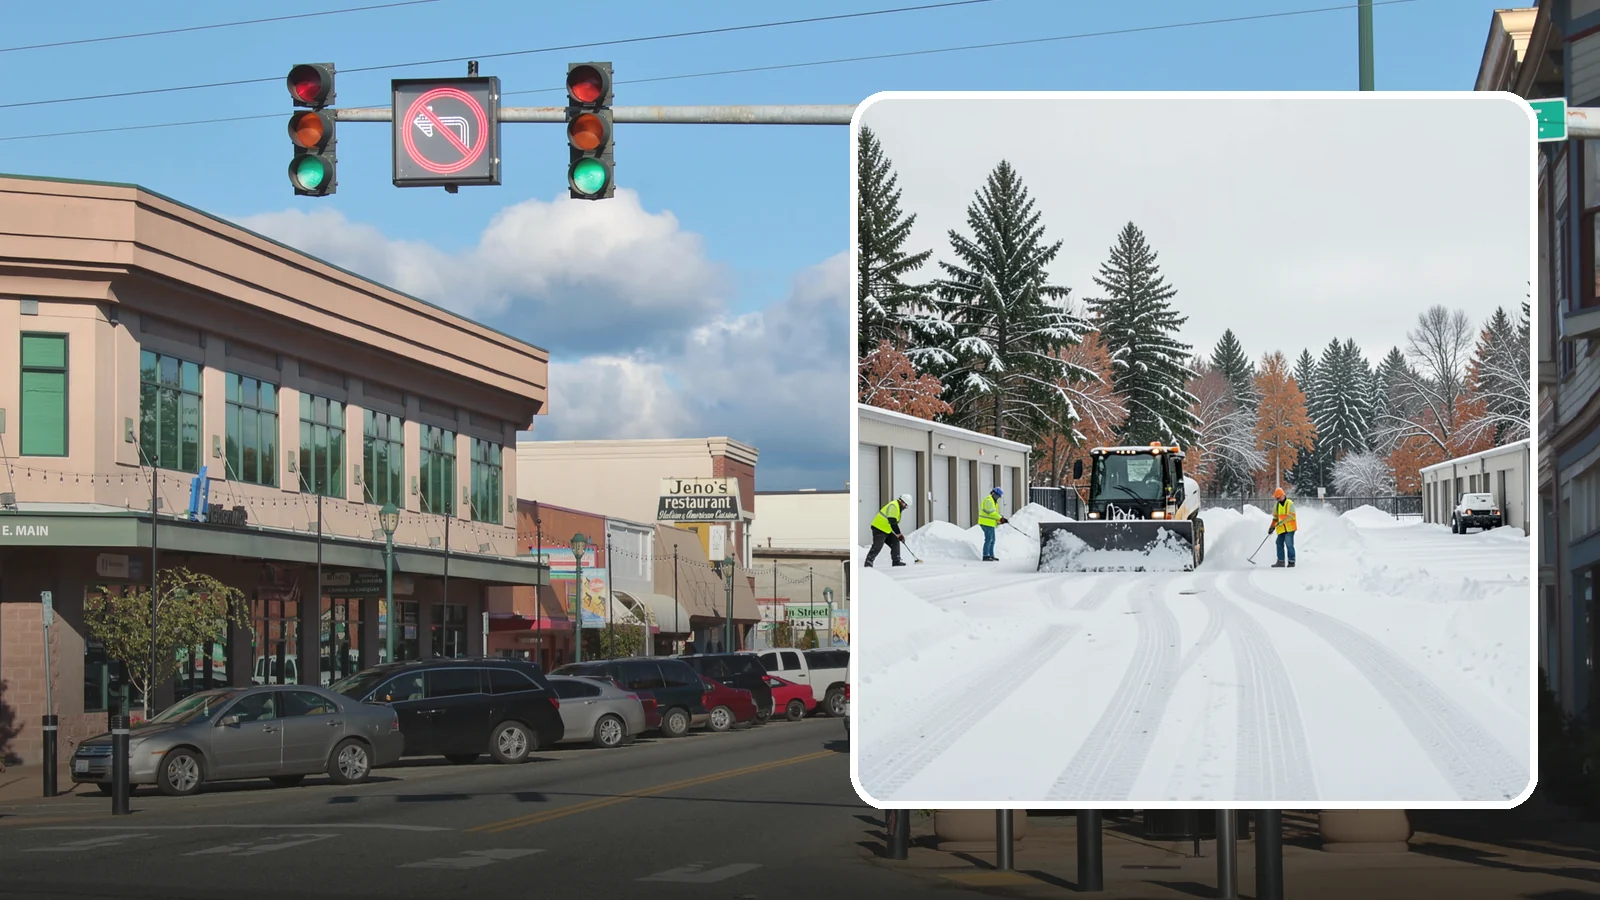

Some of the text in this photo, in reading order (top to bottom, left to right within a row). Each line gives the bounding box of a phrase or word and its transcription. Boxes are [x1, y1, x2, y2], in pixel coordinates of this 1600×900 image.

[670, 480, 727, 494] Jeno's
[665, 496, 731, 508] restaurant
[686, 510, 714, 519] American
[715, 510, 737, 519] Cuisine
[2, 525, 49, 536] E. MAIN
[797, 607, 828, 616] Street
